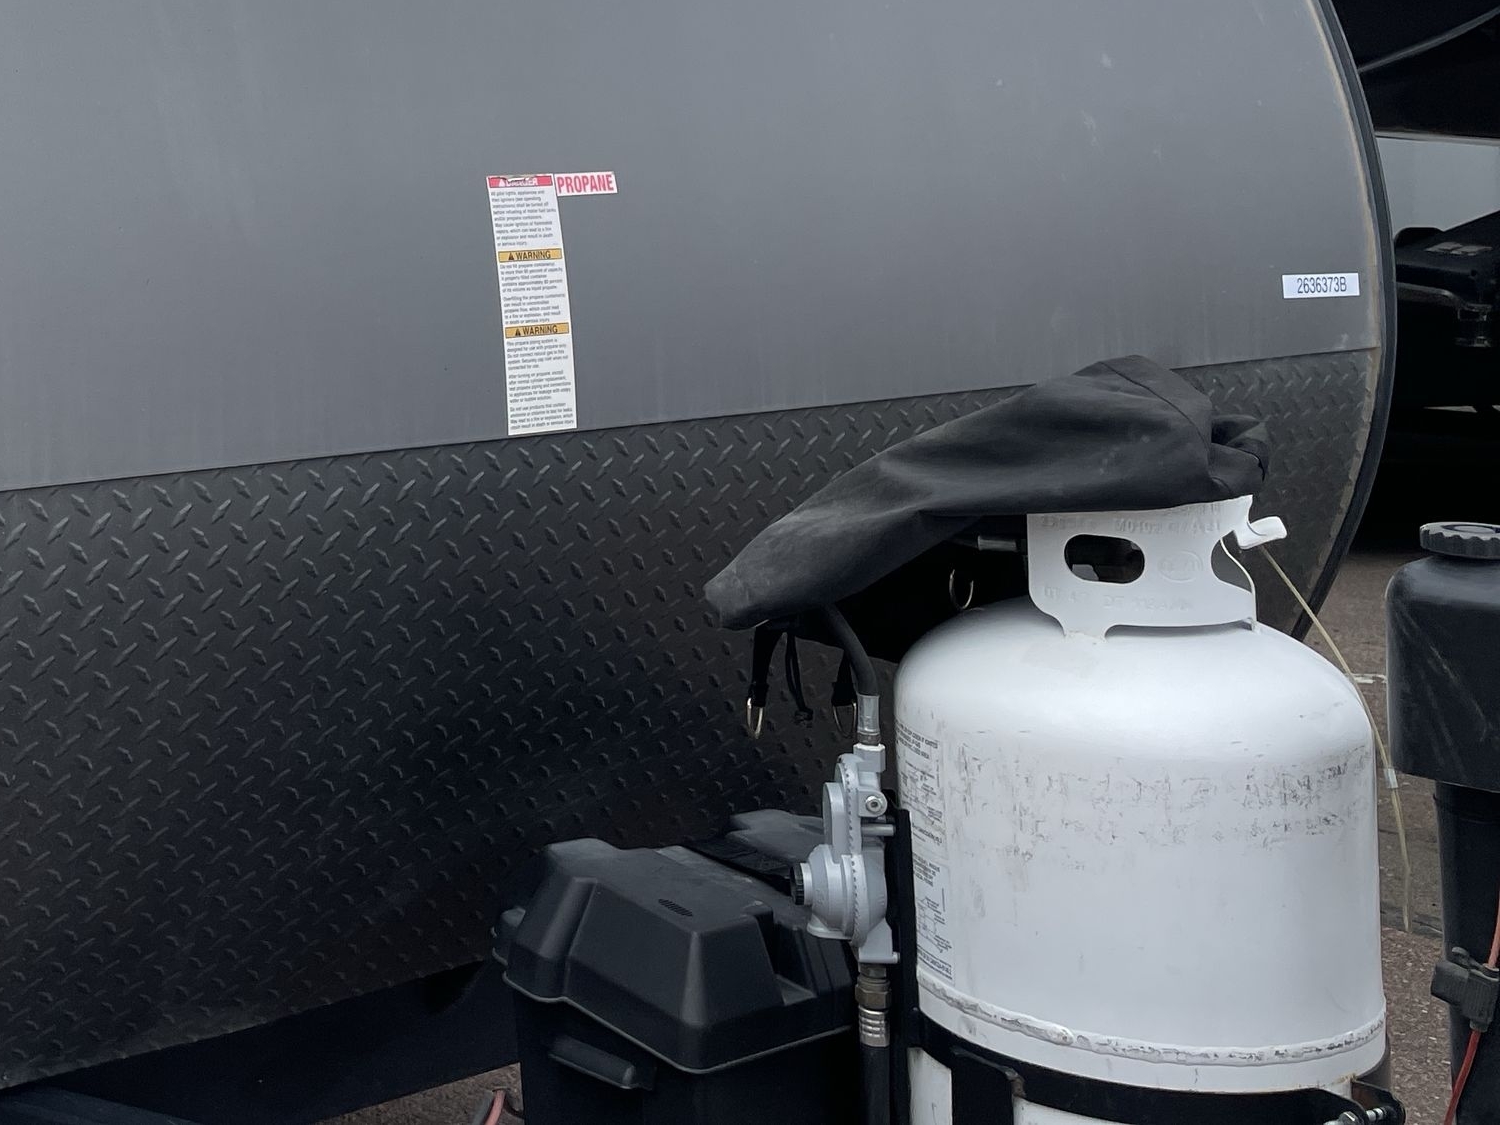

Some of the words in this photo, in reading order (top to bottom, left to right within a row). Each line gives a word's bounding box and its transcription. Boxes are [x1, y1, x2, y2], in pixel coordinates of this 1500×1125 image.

[556, 174, 615, 194] PROPANE
[516, 251, 550, 261] WARNING
[1297, 276, 1347, 294] 2636373B
[523, 325, 557, 335] WARNING
